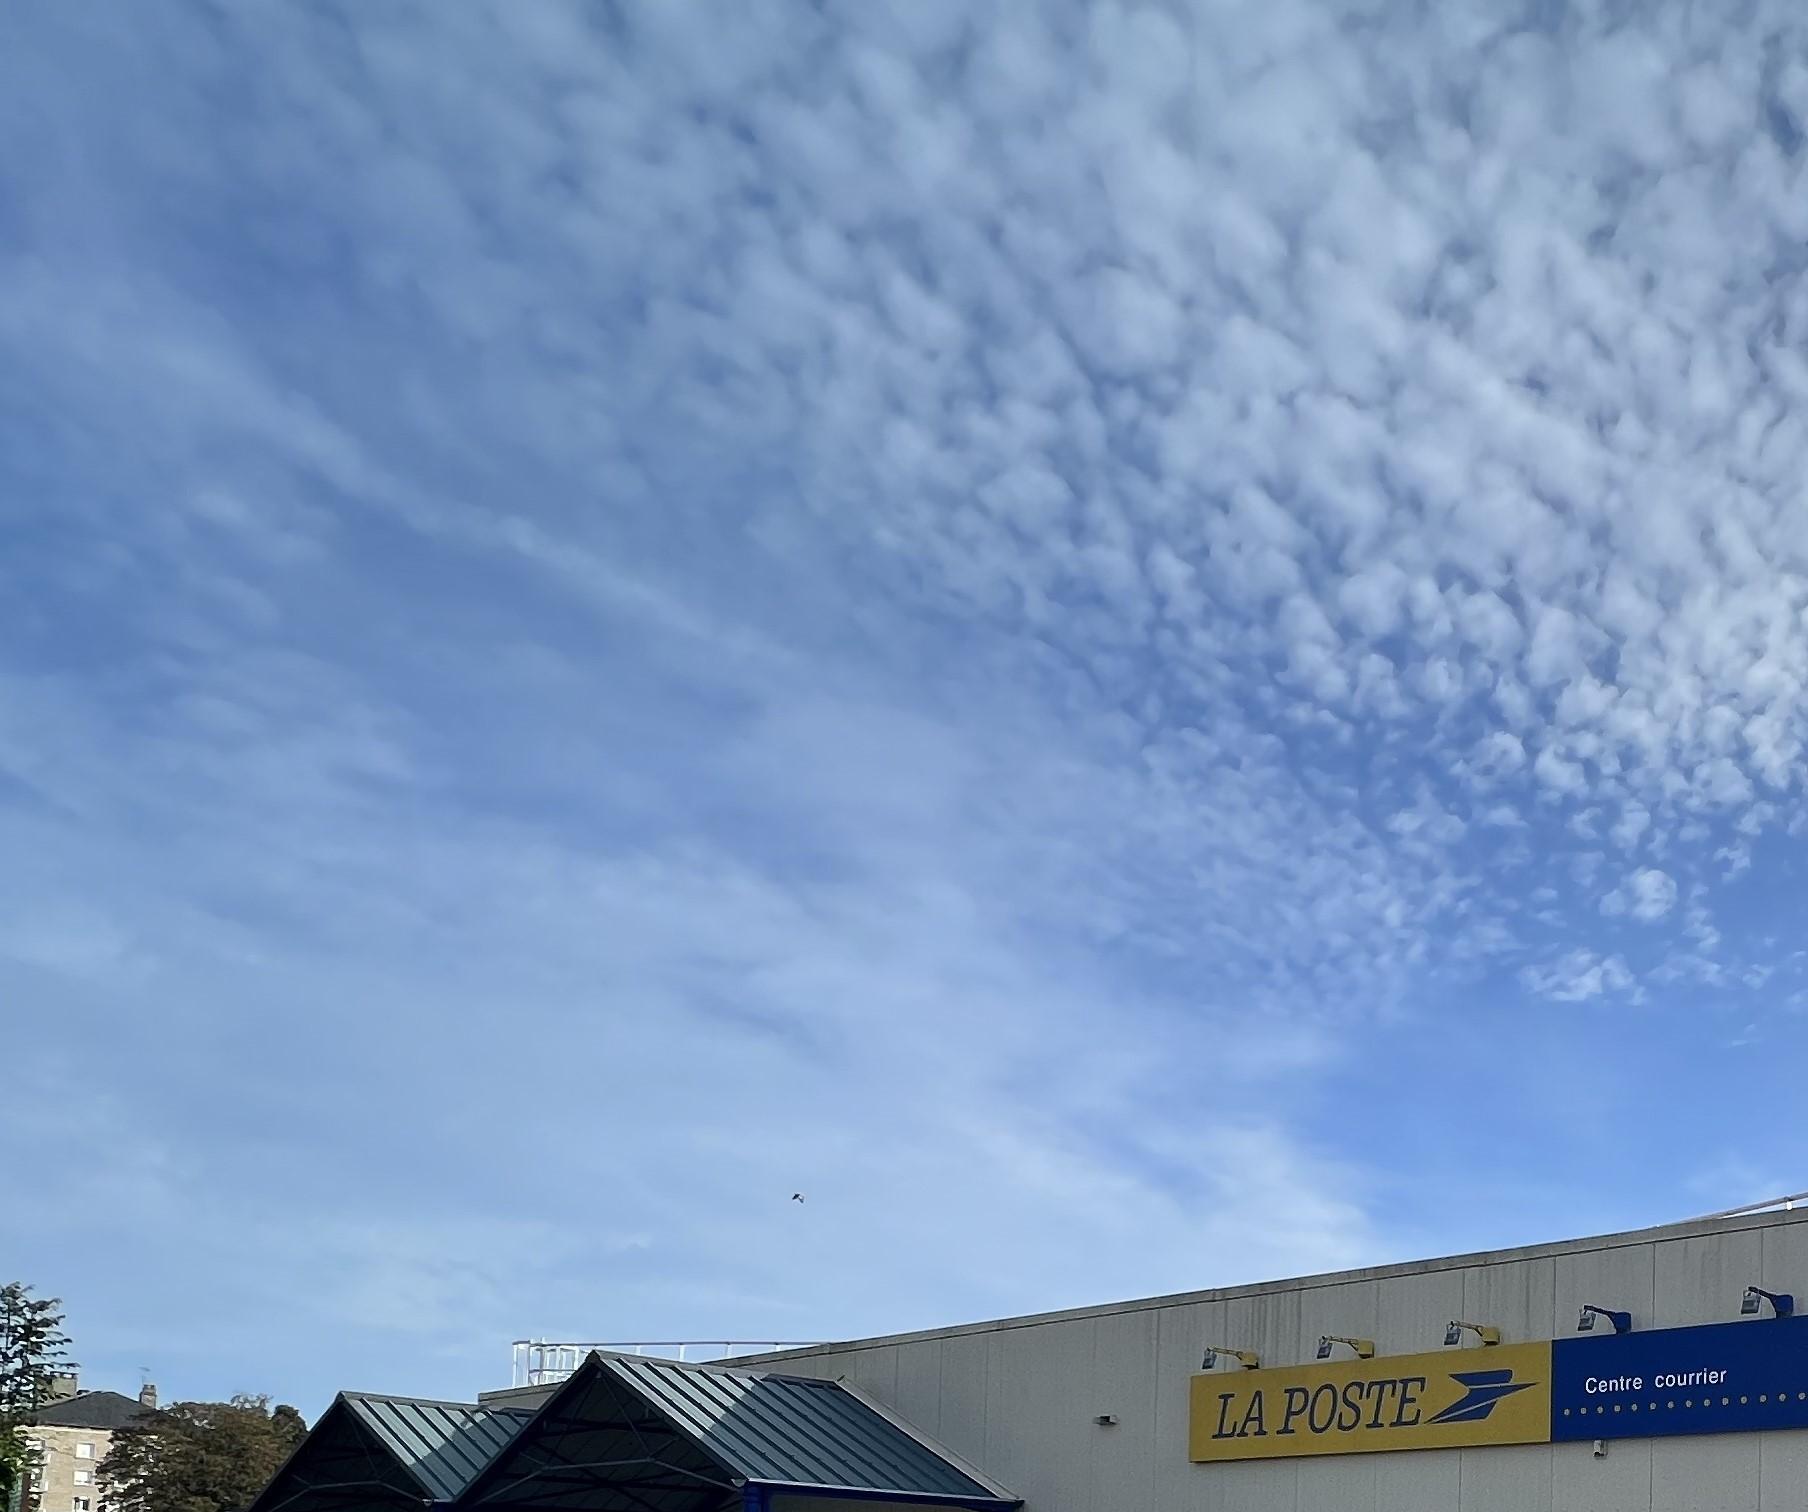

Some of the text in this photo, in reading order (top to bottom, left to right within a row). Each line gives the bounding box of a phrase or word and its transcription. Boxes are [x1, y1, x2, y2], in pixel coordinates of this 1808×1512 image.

[1585, 1367, 1727, 1394] Centre courrier
[1211, 1376, 1427, 1440] LA POSTE
